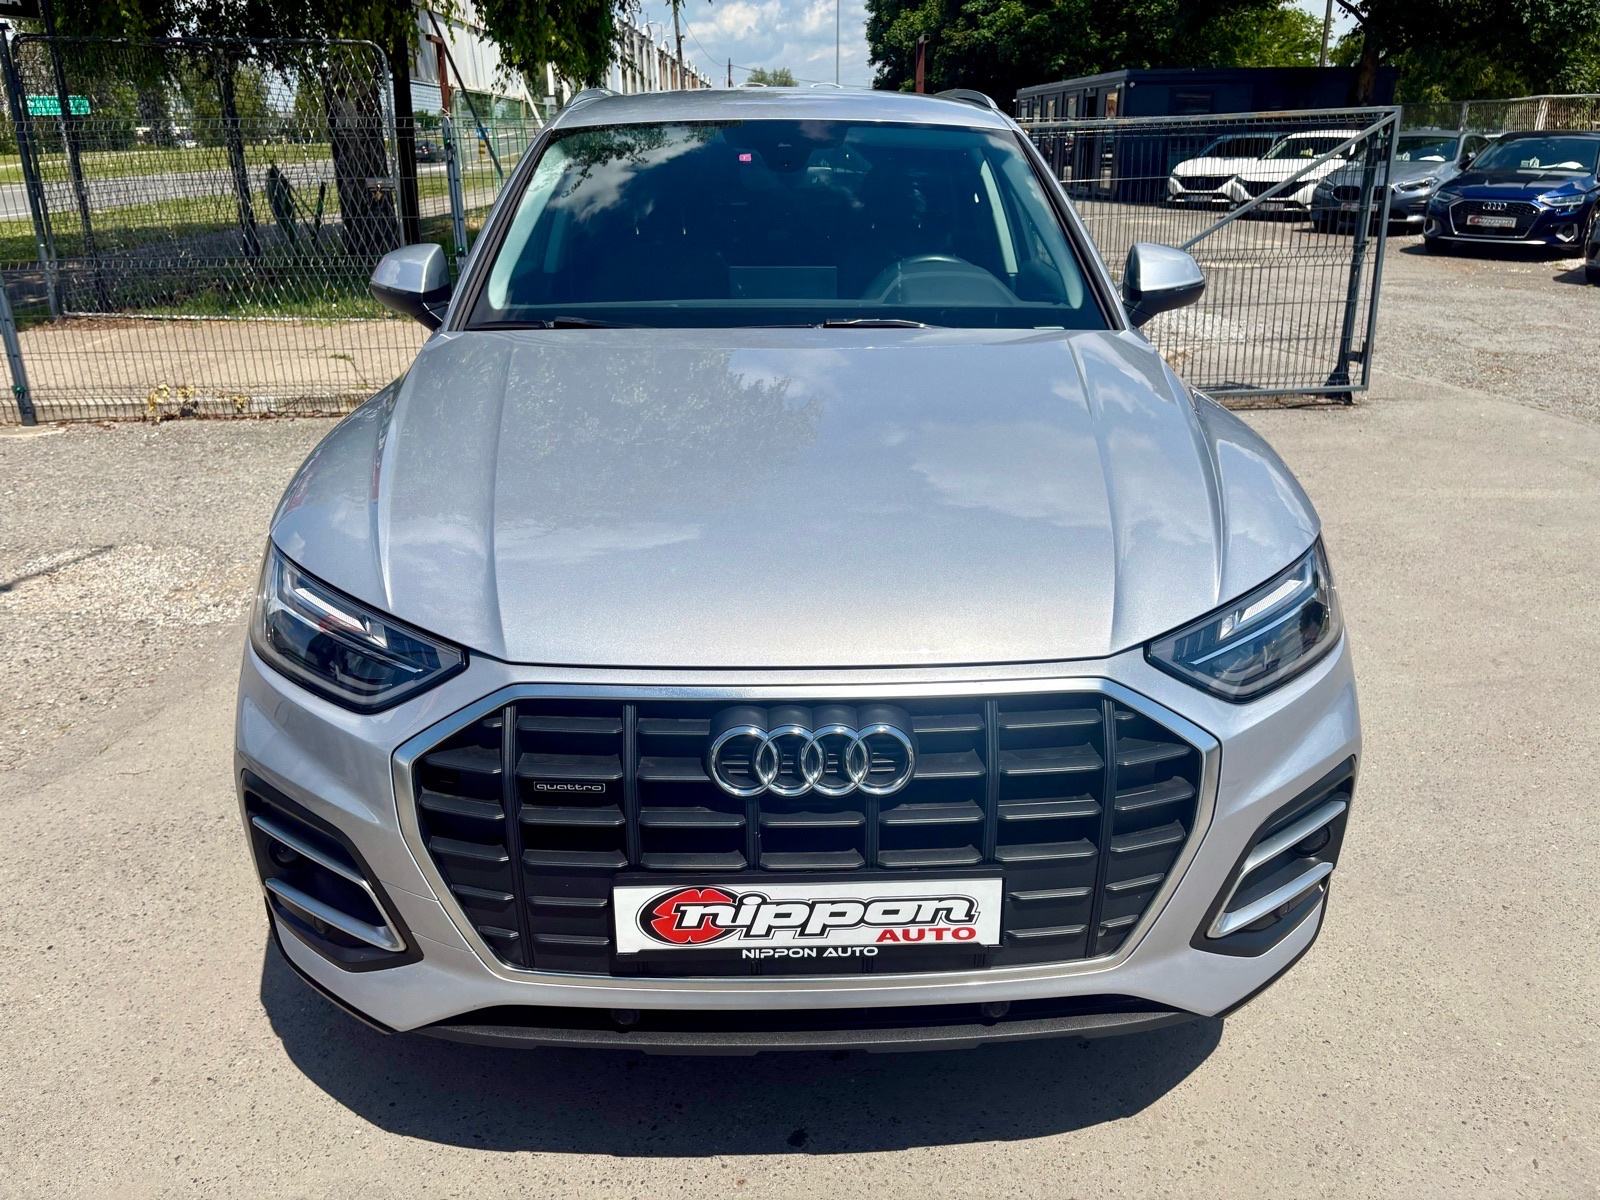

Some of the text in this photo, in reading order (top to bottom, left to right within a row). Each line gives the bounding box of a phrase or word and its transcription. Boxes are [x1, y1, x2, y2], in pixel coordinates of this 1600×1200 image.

[536, 783, 602, 791] quattro
[674, 892, 979, 938] nippon
[875, 927, 977, 943] AUTO
[741, 946, 879, 959] NIPPON AUTO
